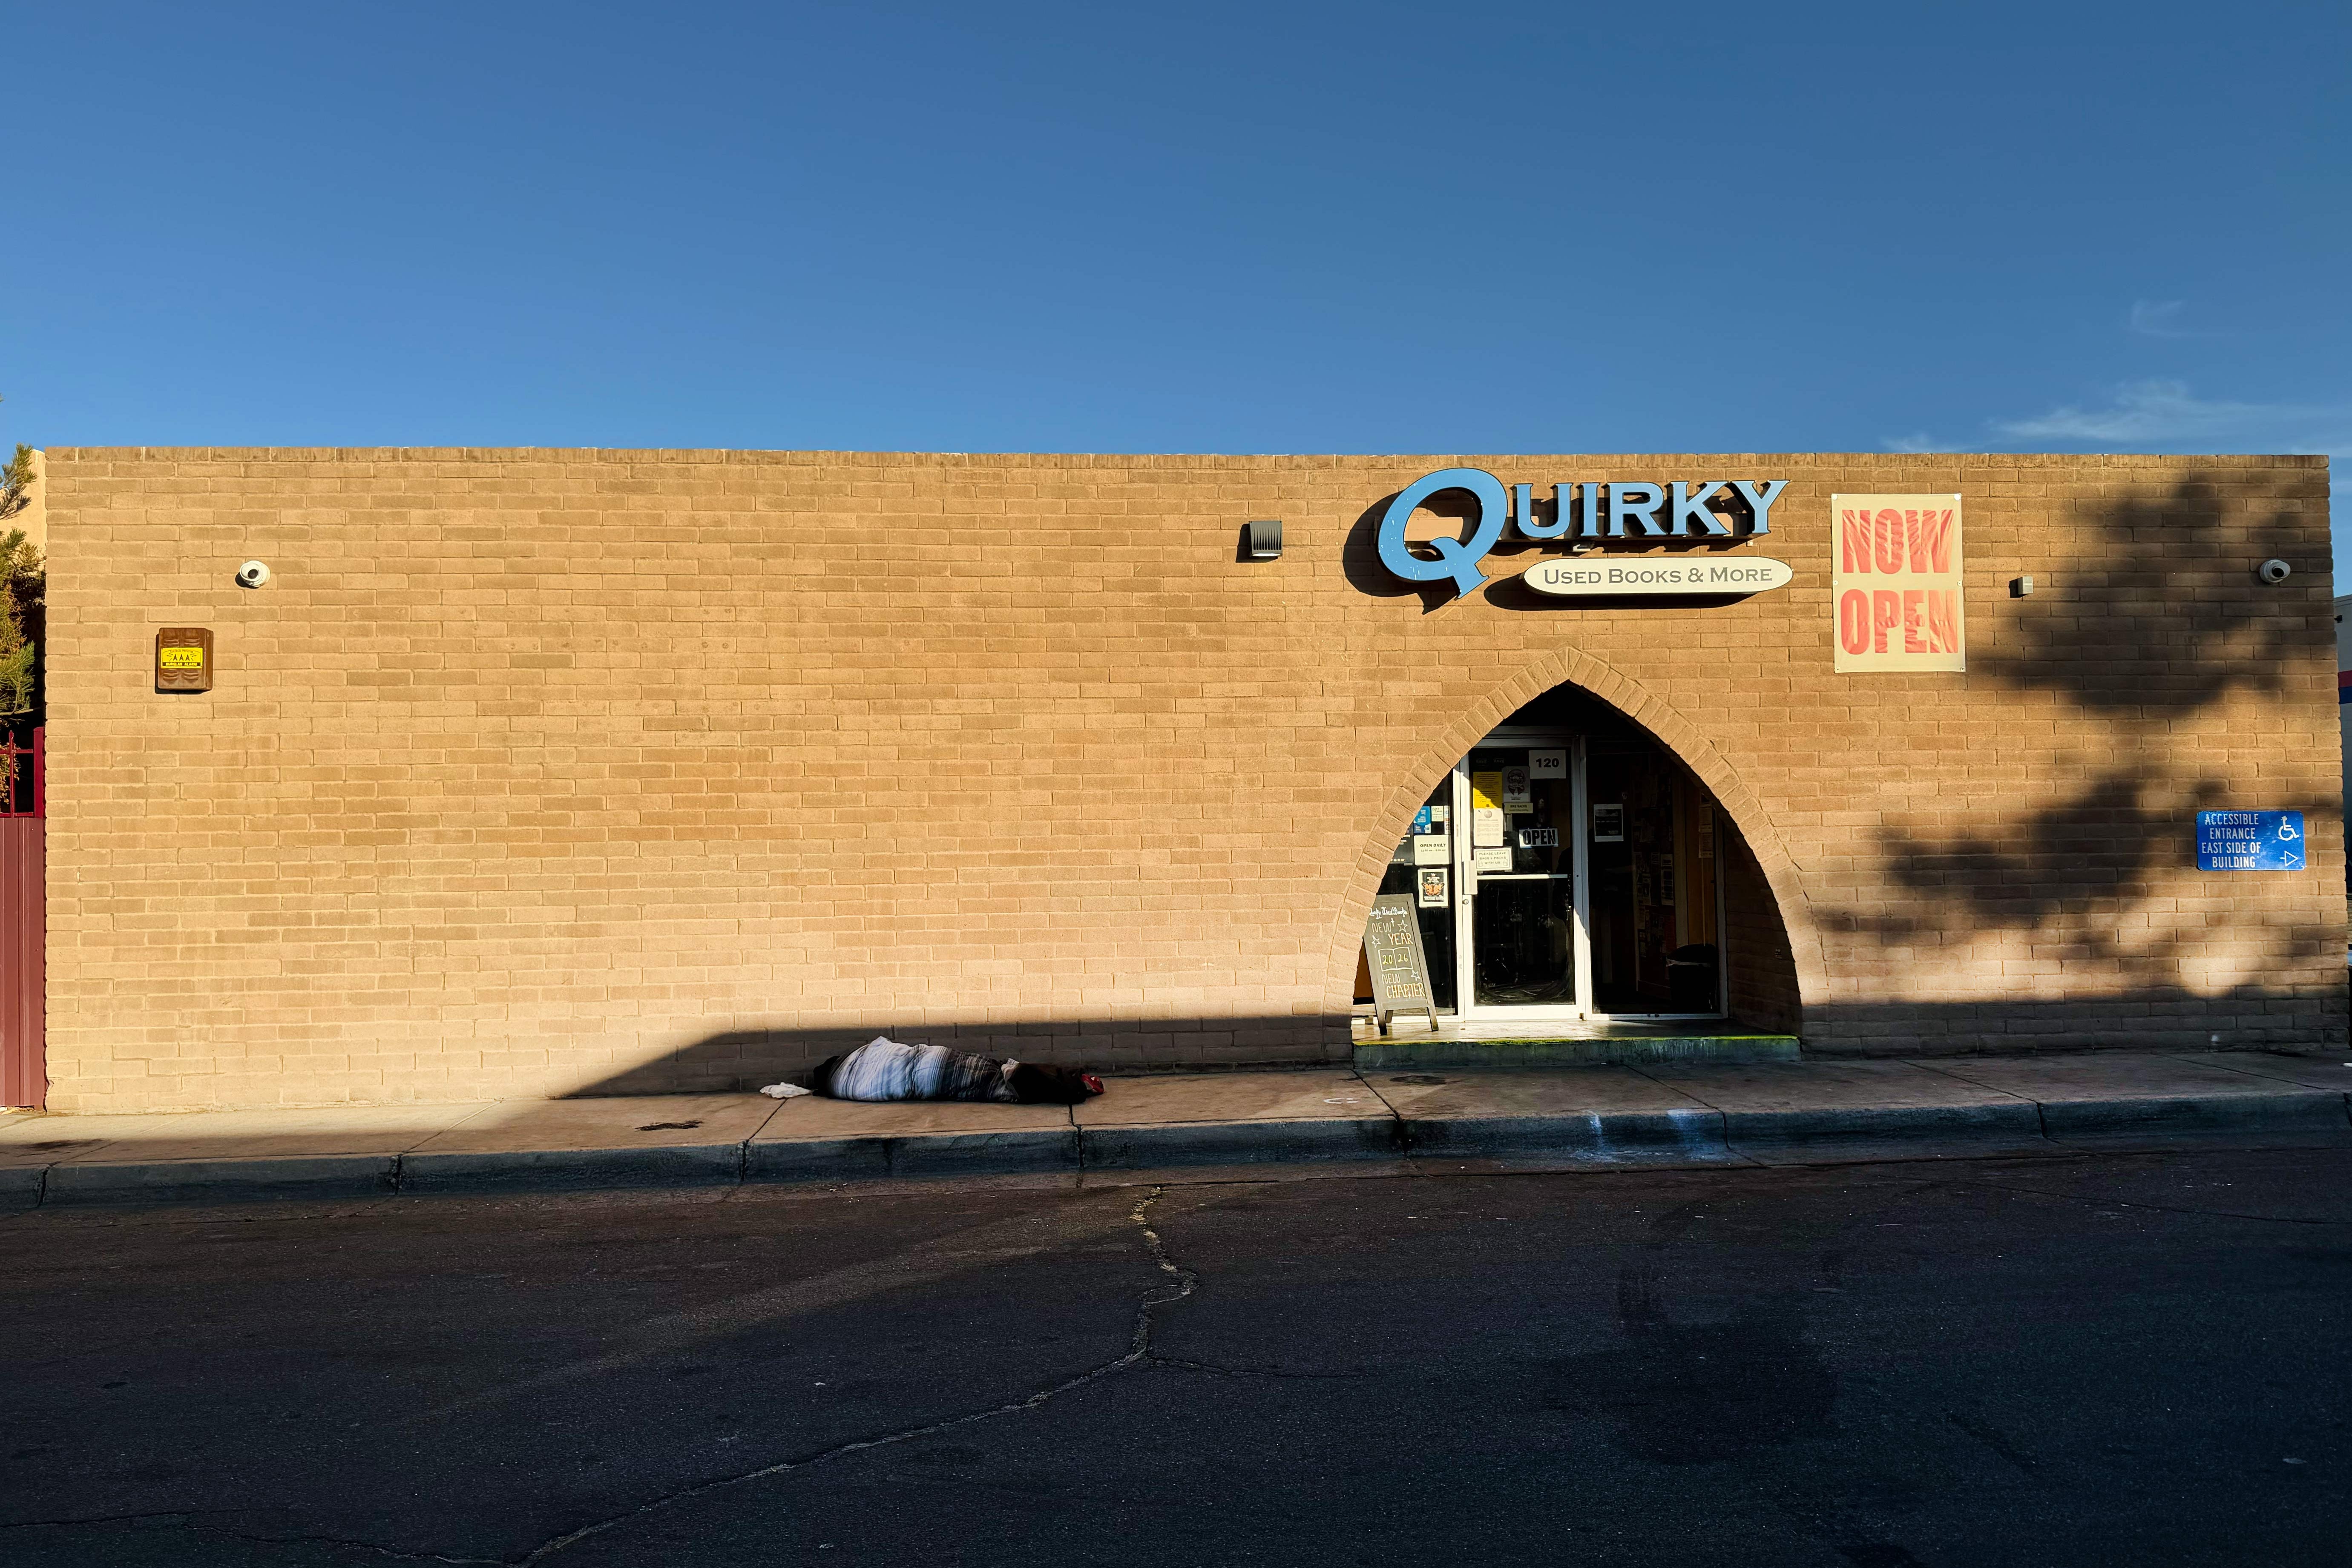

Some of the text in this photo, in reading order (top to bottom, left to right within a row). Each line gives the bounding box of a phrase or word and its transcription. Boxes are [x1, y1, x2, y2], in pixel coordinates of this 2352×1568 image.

[1378, 467, 1791, 600] QUIRKY
[1842, 508, 1954, 574] NOW
[1687, 567, 1704, 583] &
[1840, 589, 1958, 655] OPEN
[1535, 758, 1559, 768] 120
[2205, 813, 2259, 825] ACCESSIBLE
[1522, 829, 1556, 845] OPEN
[2210, 828, 2256, 839] ENTRANCE
[2202, 842, 2261, 853] EAST SIDE OF
[2212, 856, 2256, 868] BUILDING
[1372, 922, 1392, 933] NEW
[1388, 932, 1414, 945] YEAR
[1382, 953, 1408, 965] 20 26
[1381, 973, 1400, 984] NEW
[1386, 982, 1426, 999] CHAPTER
